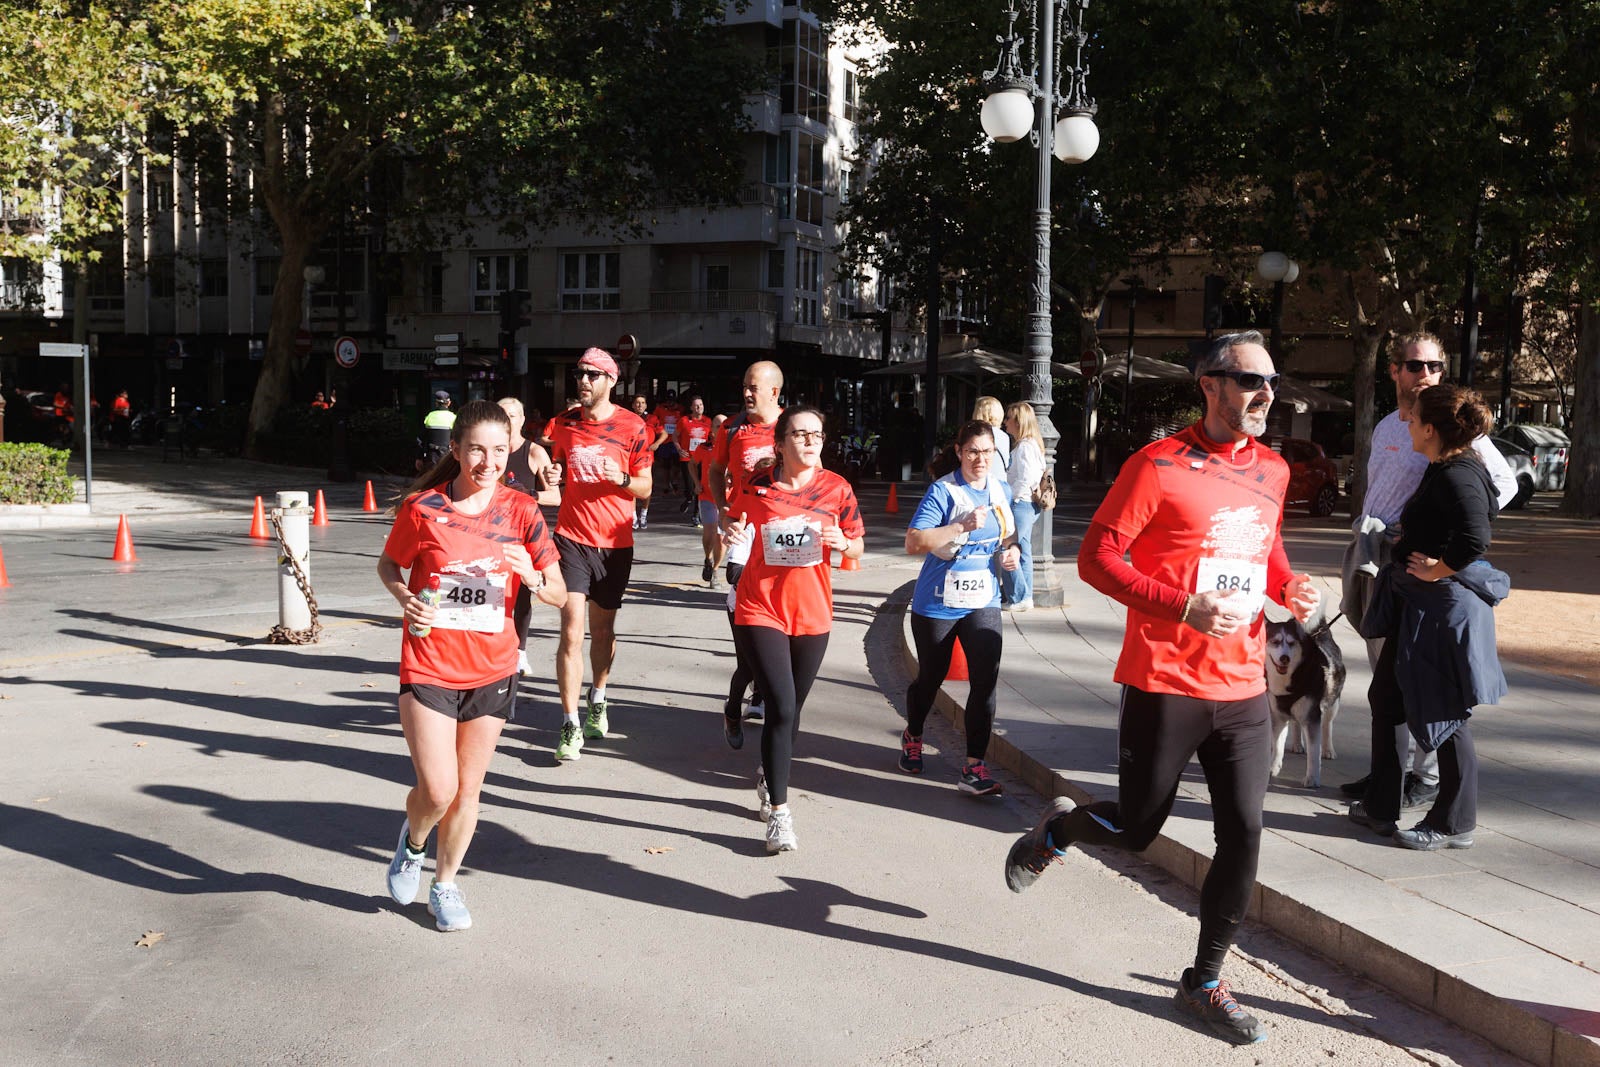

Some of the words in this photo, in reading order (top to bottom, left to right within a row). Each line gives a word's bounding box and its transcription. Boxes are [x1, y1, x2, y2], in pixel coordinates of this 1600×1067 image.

[775, 533, 805, 547] 487
[953, 578, 985, 591] 1524
[1216, 574, 1251, 595] 884
[447, 586, 486, 605] 488
